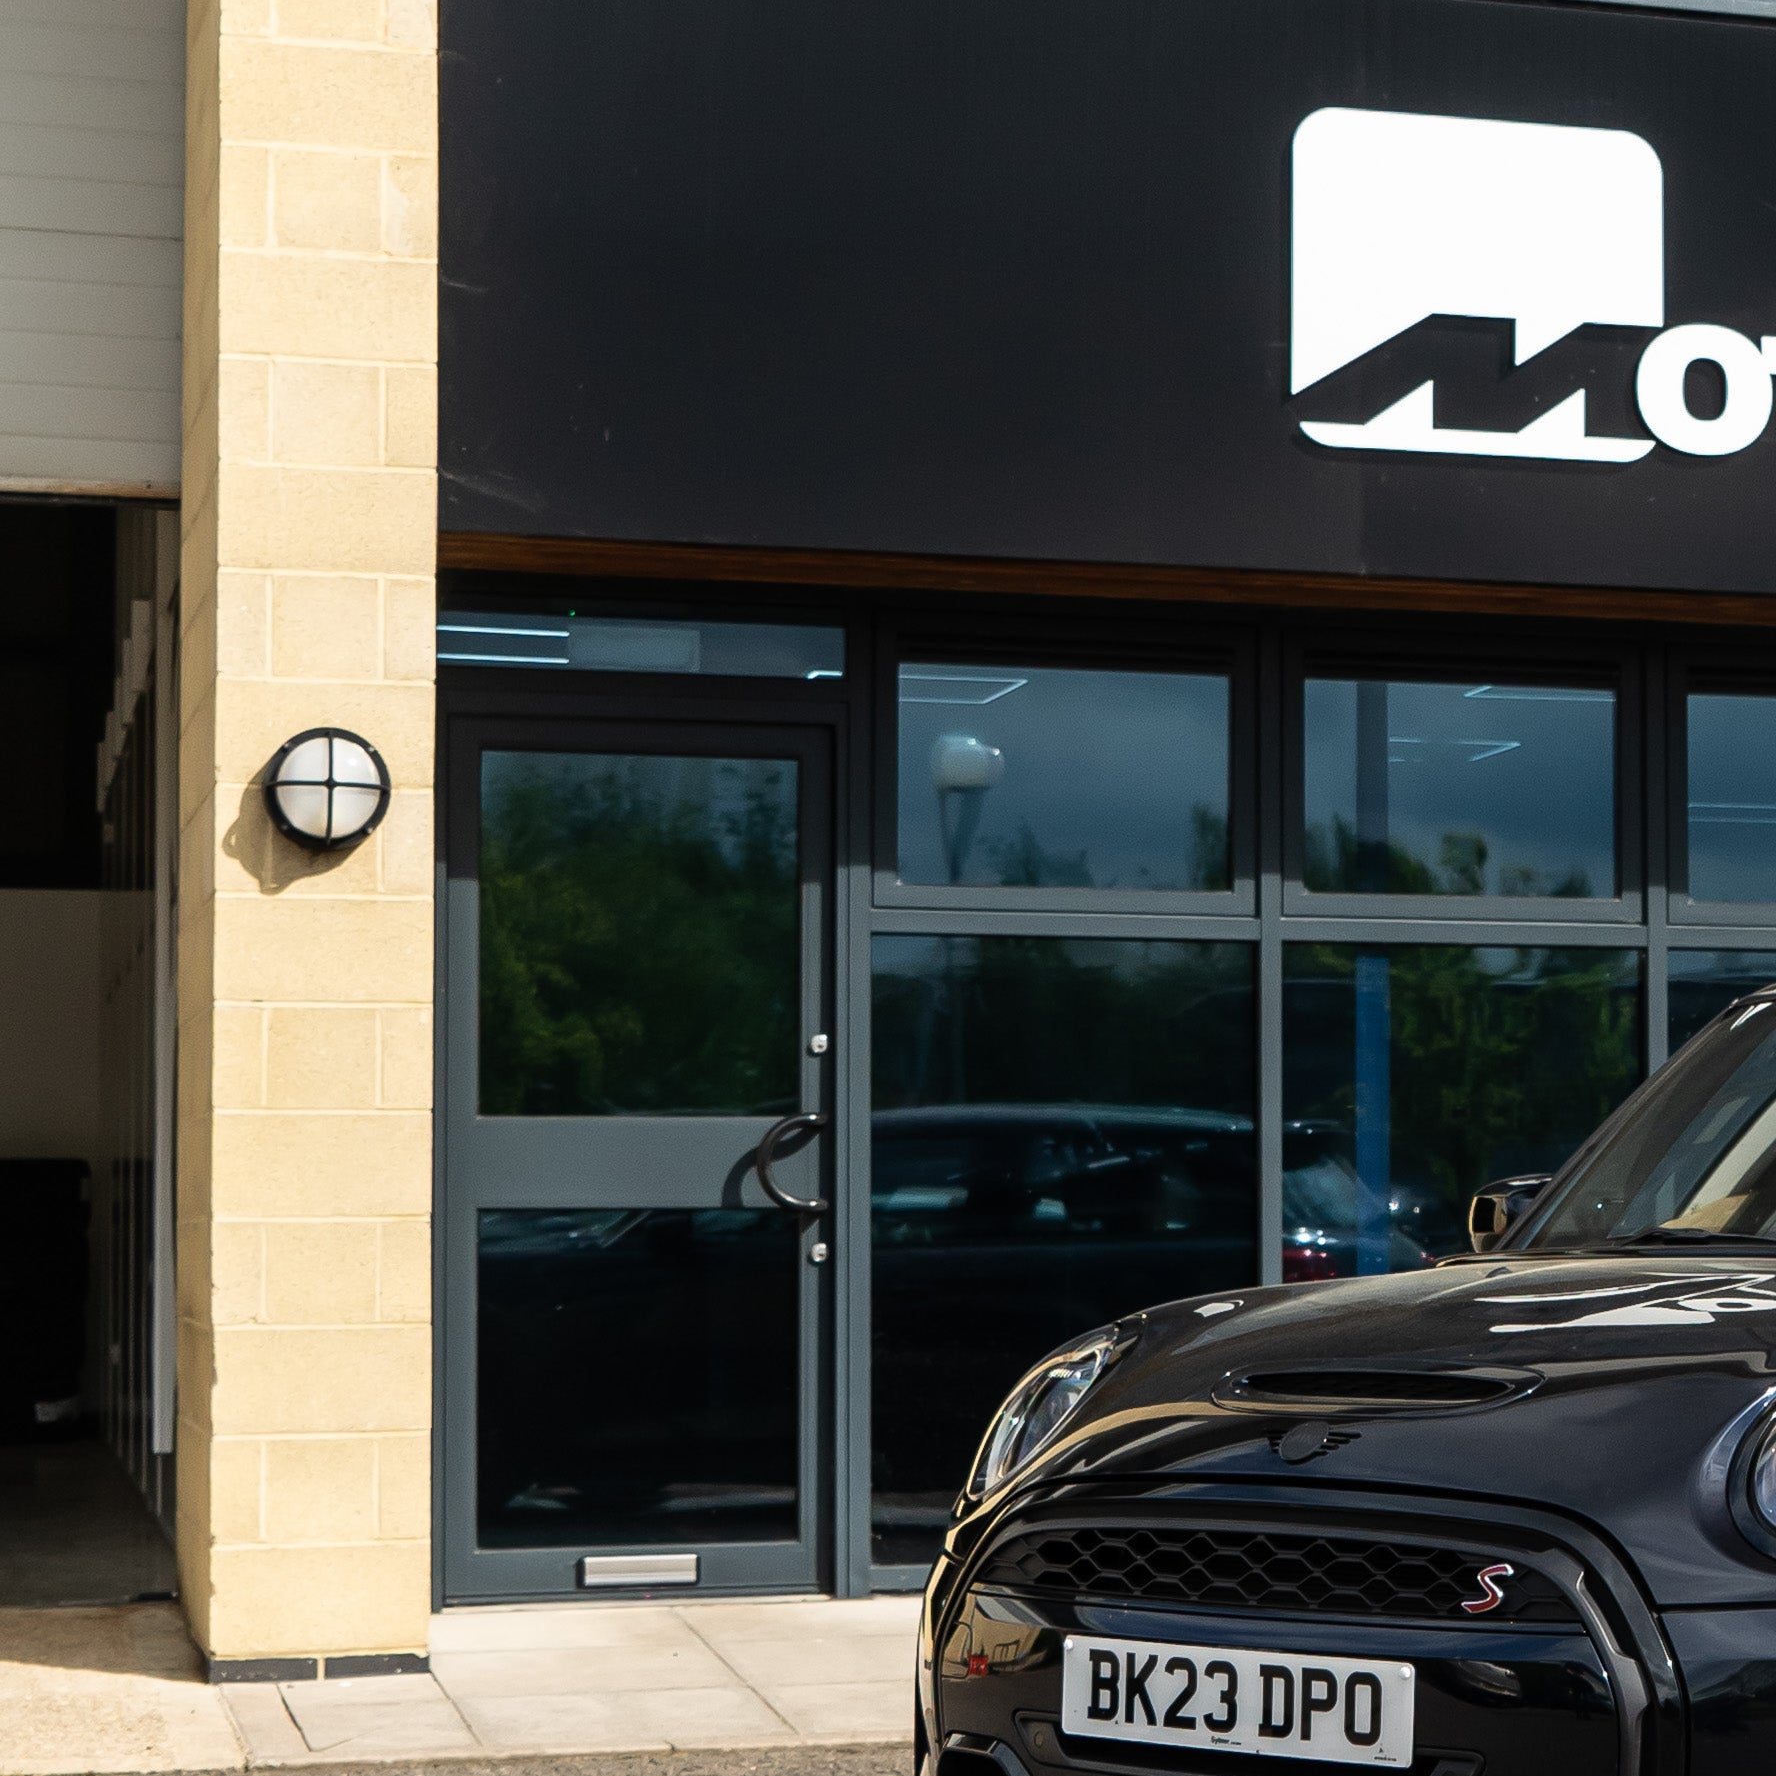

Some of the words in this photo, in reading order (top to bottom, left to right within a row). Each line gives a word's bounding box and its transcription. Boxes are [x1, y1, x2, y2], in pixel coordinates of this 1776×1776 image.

[1460, 1563, 1514, 1614] S
[1087, 1648, 1239, 1734] BK23
[1258, 1663, 1383, 1747] DPO
